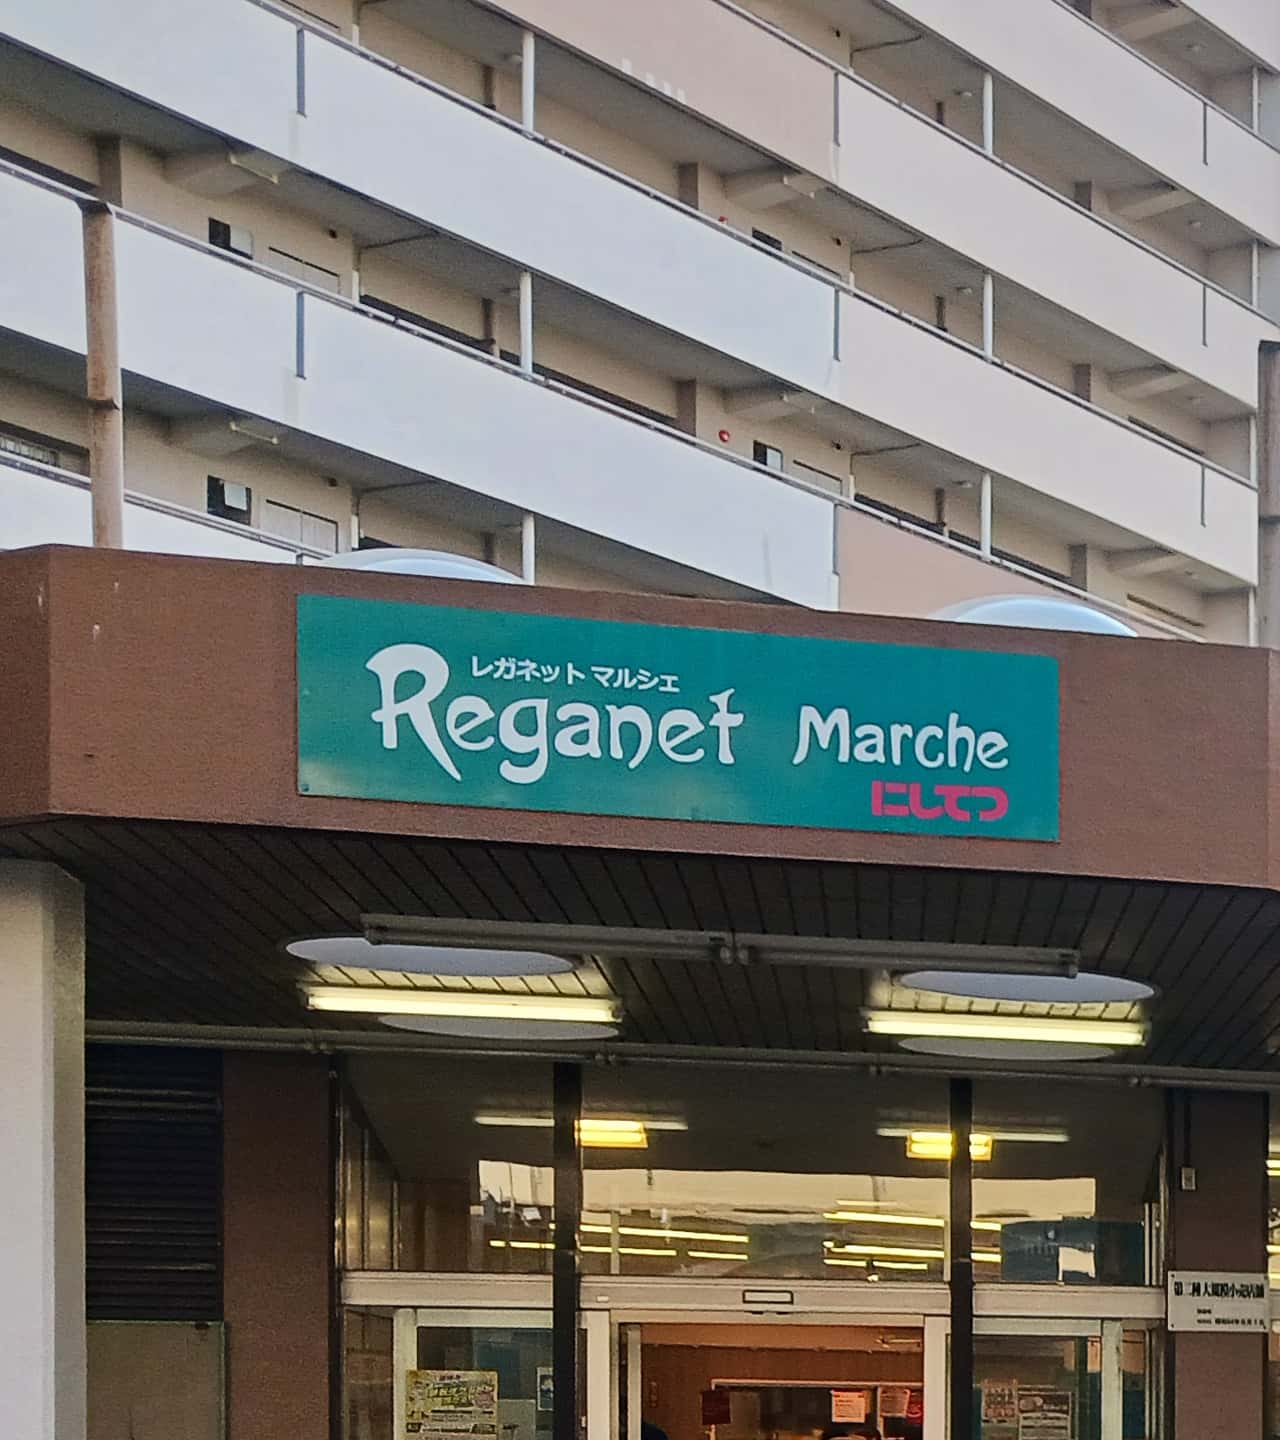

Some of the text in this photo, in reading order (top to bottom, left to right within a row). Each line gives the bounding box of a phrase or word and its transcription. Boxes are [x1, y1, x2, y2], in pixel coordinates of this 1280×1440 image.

[471, 655, 681, 694] レガネット マルシェ
[365, 643, 1010, 785] Reganet Marche
[871, 780, 1009, 823] にしてつ
